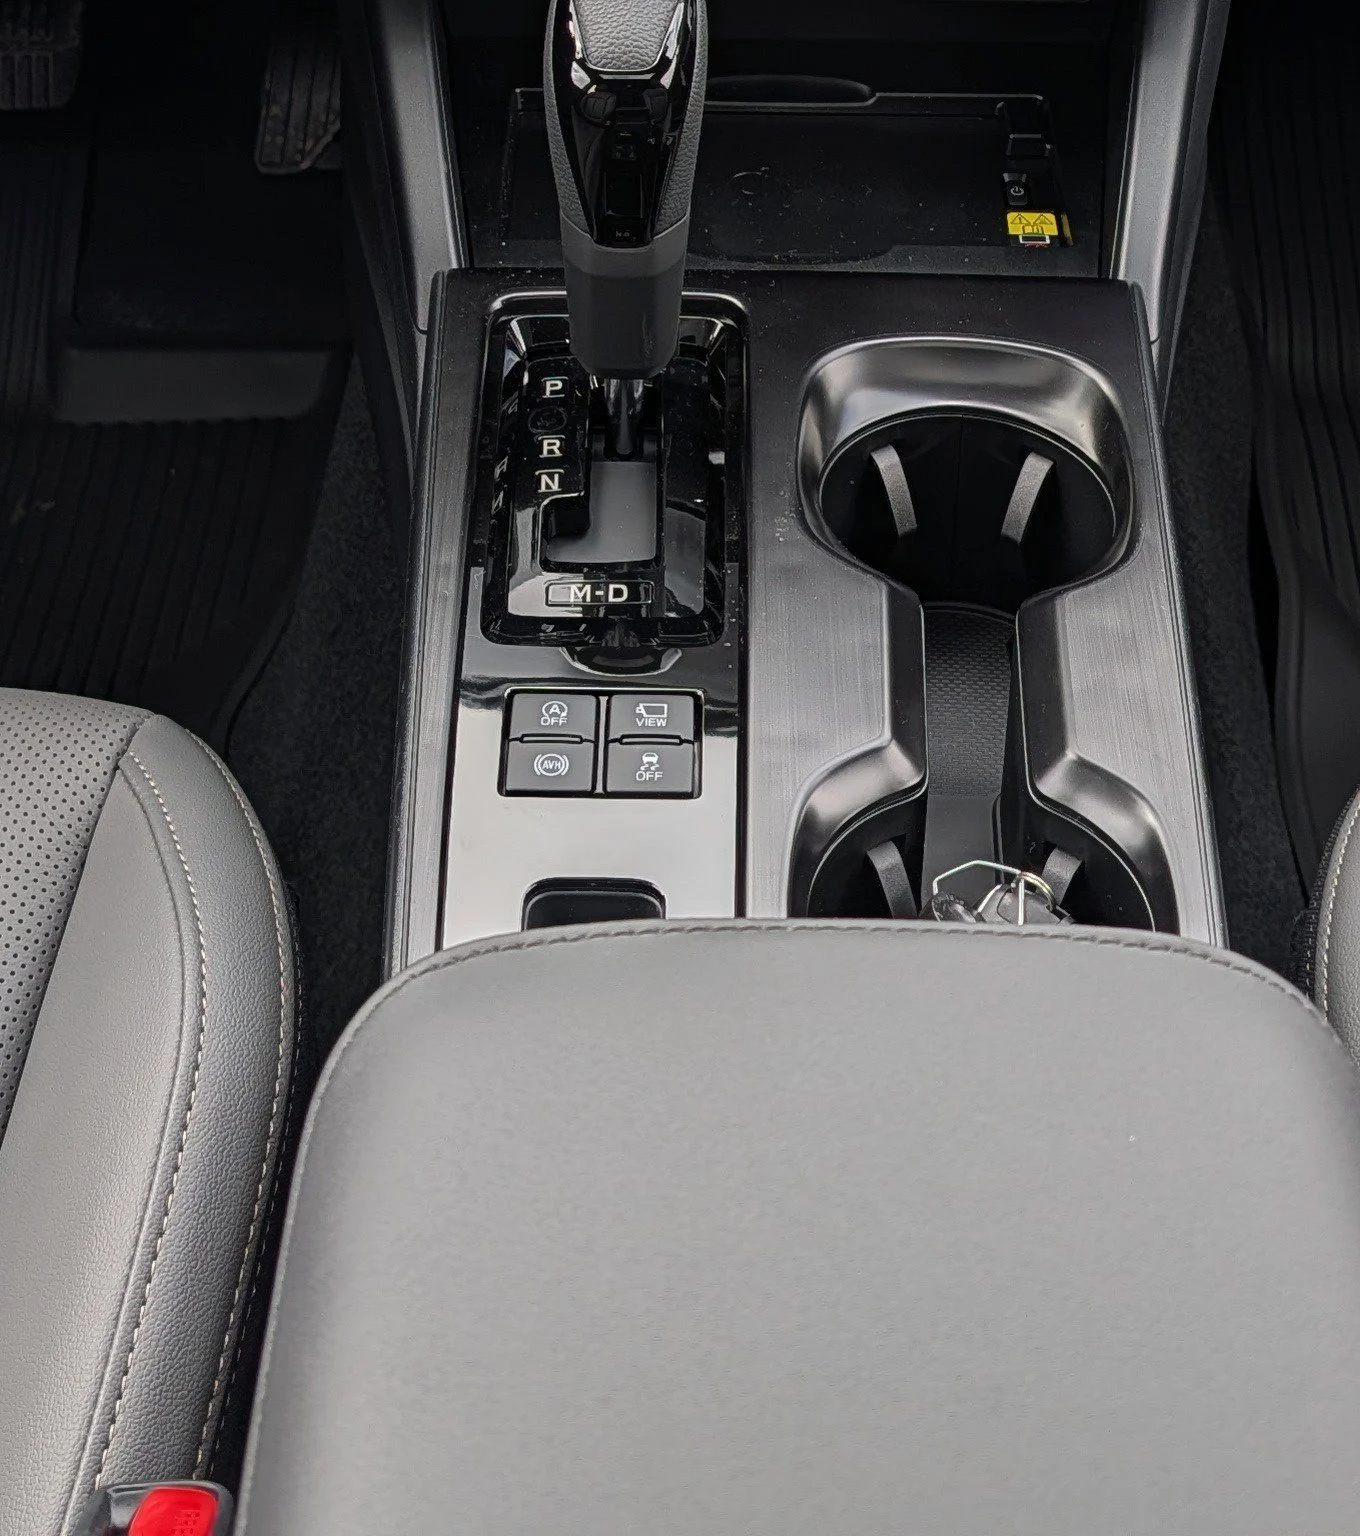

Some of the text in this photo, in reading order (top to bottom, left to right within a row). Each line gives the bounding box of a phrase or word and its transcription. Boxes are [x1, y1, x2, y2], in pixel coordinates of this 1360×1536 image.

[545, 380, 563, 395] P
[542, 440, 561, 454] R
[540, 474, 560, 490] N
[540, 717, 567, 726] OFF
[636, 718, 667, 727] VIEW
[542, 759, 561, 769] AVH
[636, 771, 663, 781] OFF
